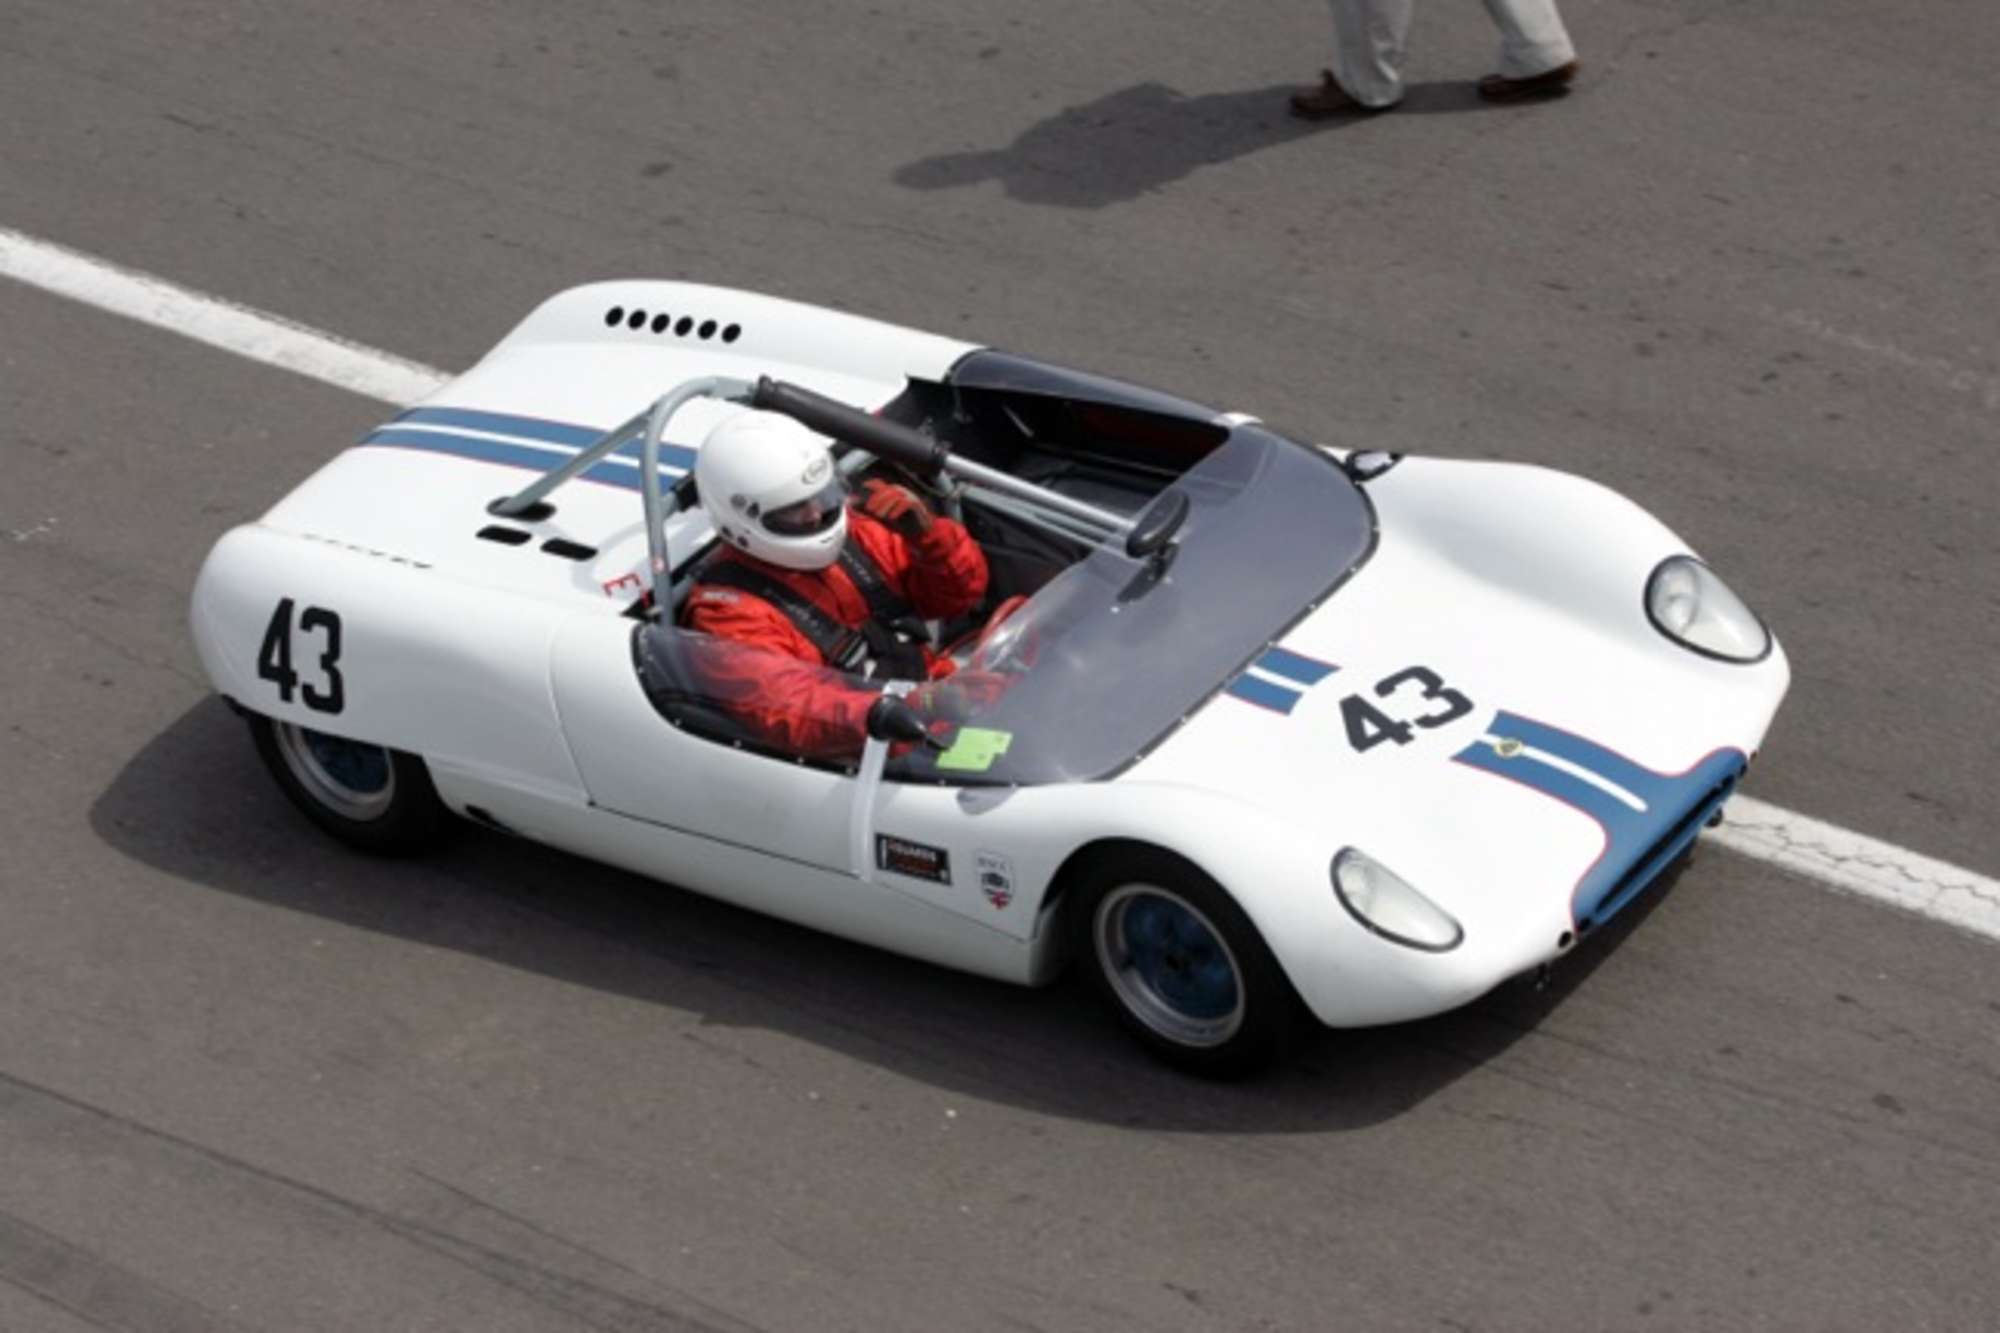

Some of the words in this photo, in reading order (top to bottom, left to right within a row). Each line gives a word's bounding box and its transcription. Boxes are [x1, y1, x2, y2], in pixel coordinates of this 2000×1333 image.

[603, 573, 640, 598] E
[257, 597, 345, 716] 43
[1339, 666, 1474, 753] 43
